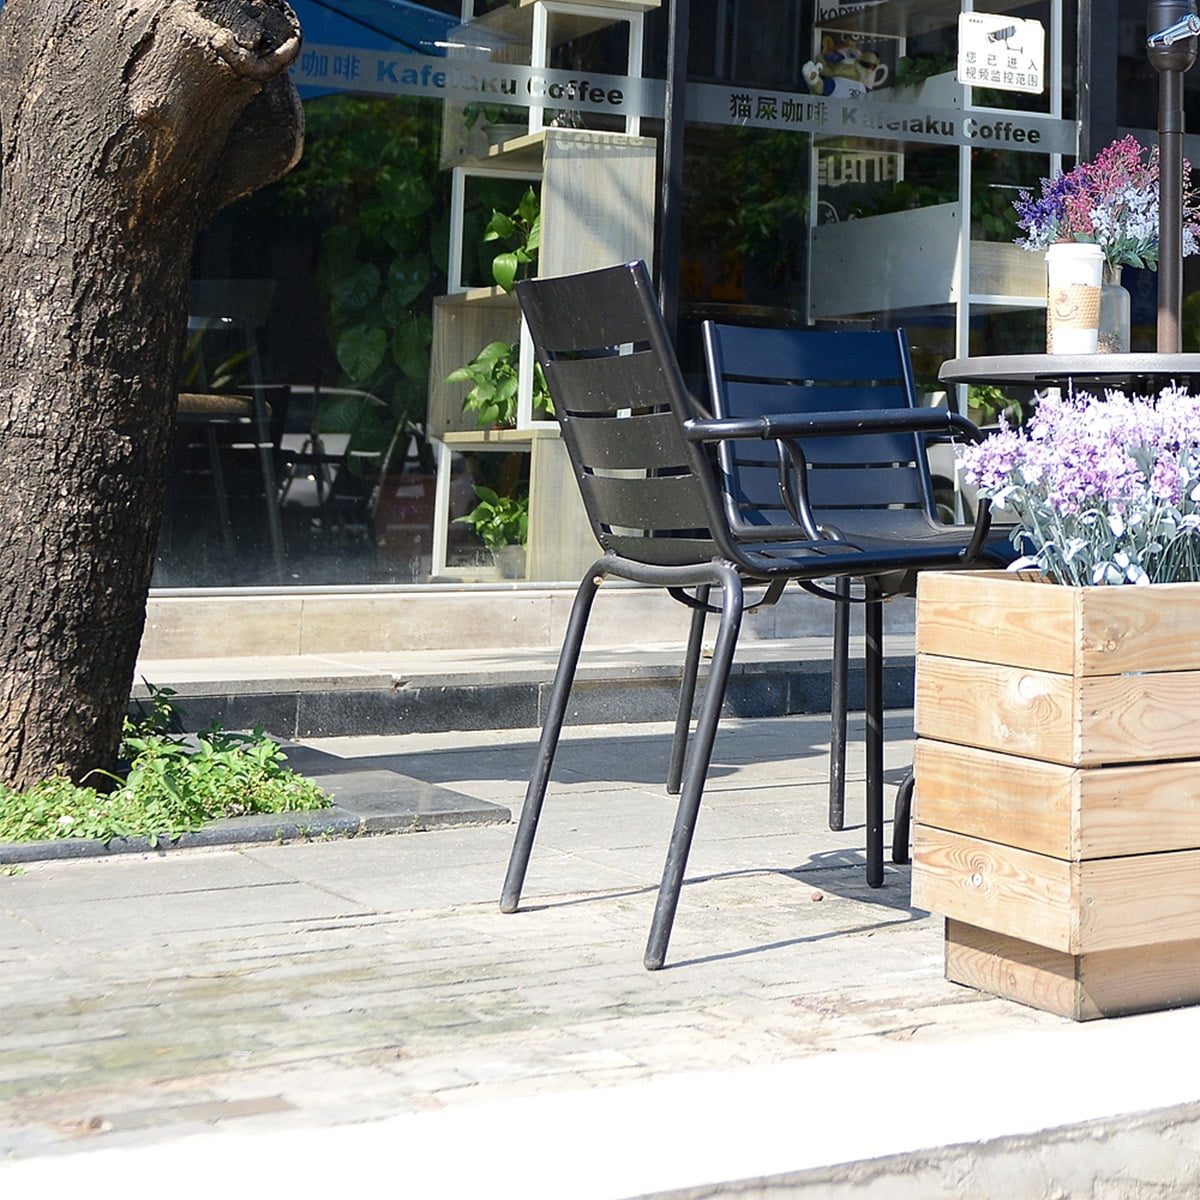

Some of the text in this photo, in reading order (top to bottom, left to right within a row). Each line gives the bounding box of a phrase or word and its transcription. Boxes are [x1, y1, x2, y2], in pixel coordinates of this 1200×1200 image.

[290, 51, 360, 81] 咖啡
[527, 75, 624, 105] Coffee
[730, 94, 828, 125] 猫屎咖啡
[963, 118, 1041, 145] Coffee
